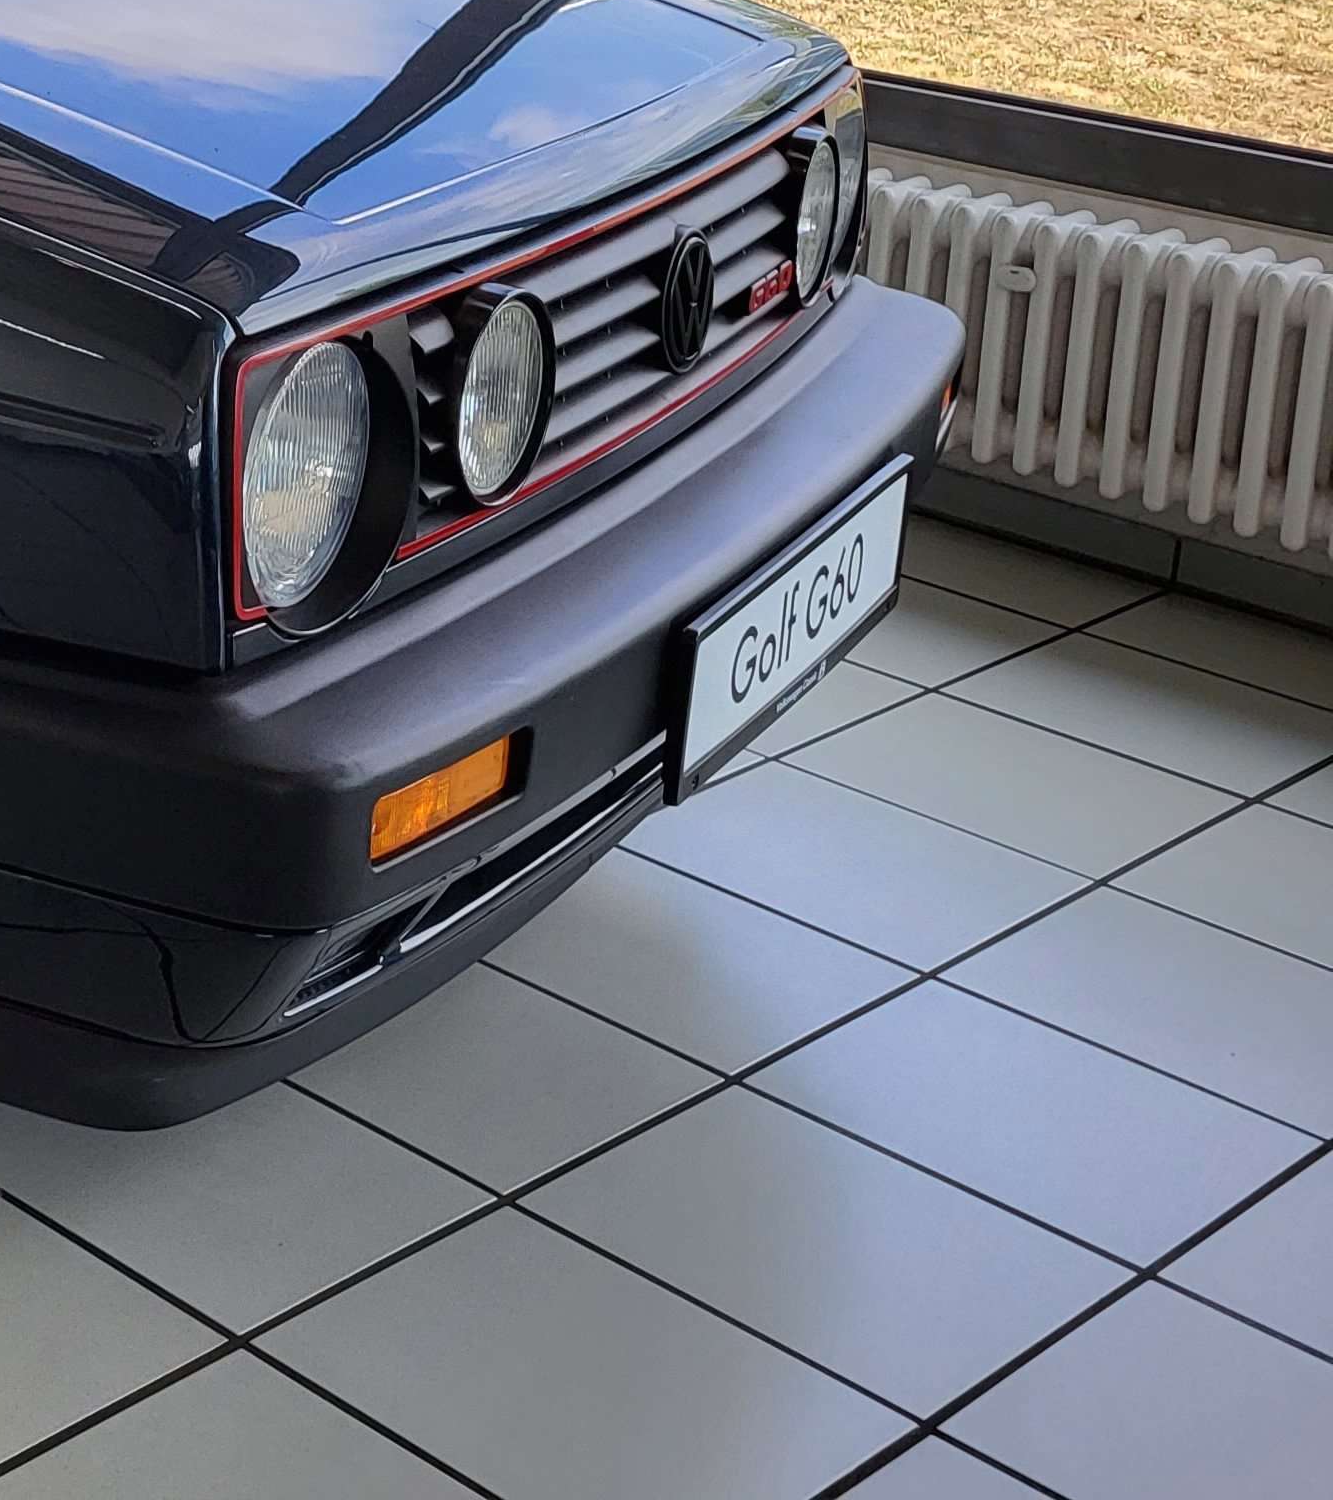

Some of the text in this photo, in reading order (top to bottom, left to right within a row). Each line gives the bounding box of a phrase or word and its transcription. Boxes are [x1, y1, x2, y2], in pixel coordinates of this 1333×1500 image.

[749, 260, 793, 313] G60
[731, 533, 864, 704] Golf G60
